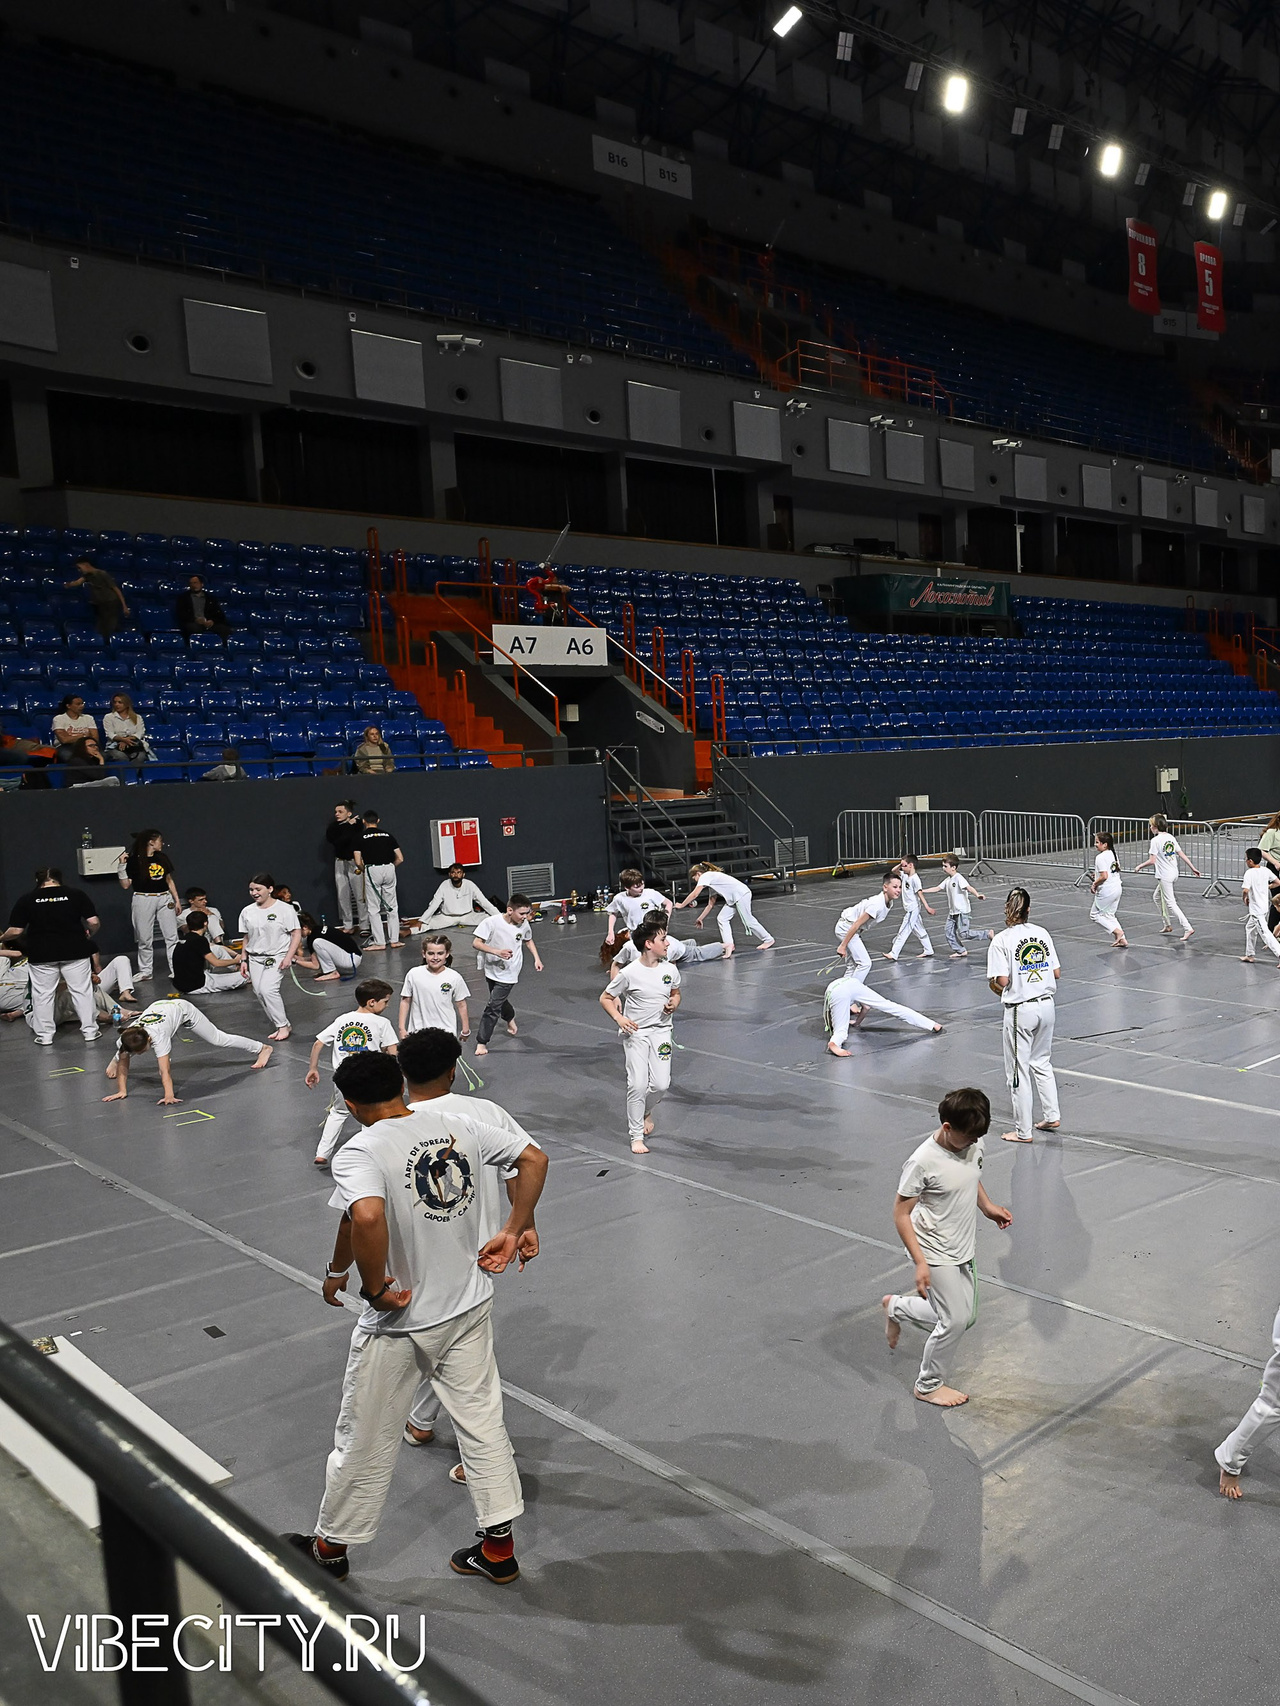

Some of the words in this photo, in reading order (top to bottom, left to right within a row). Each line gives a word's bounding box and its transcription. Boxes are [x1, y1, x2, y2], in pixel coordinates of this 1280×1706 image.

[608, 152, 628, 168] B16
[659, 168, 678, 183] B15
[1138, 253, 1146, 276] 8
[1204, 269, 1214, 297] 5
[509, 636, 537, 654] A7
[566, 637, 594, 655] A6
[404, 1158, 414, 1179] ARTE
[409, 1146, 420, 1157] DE
